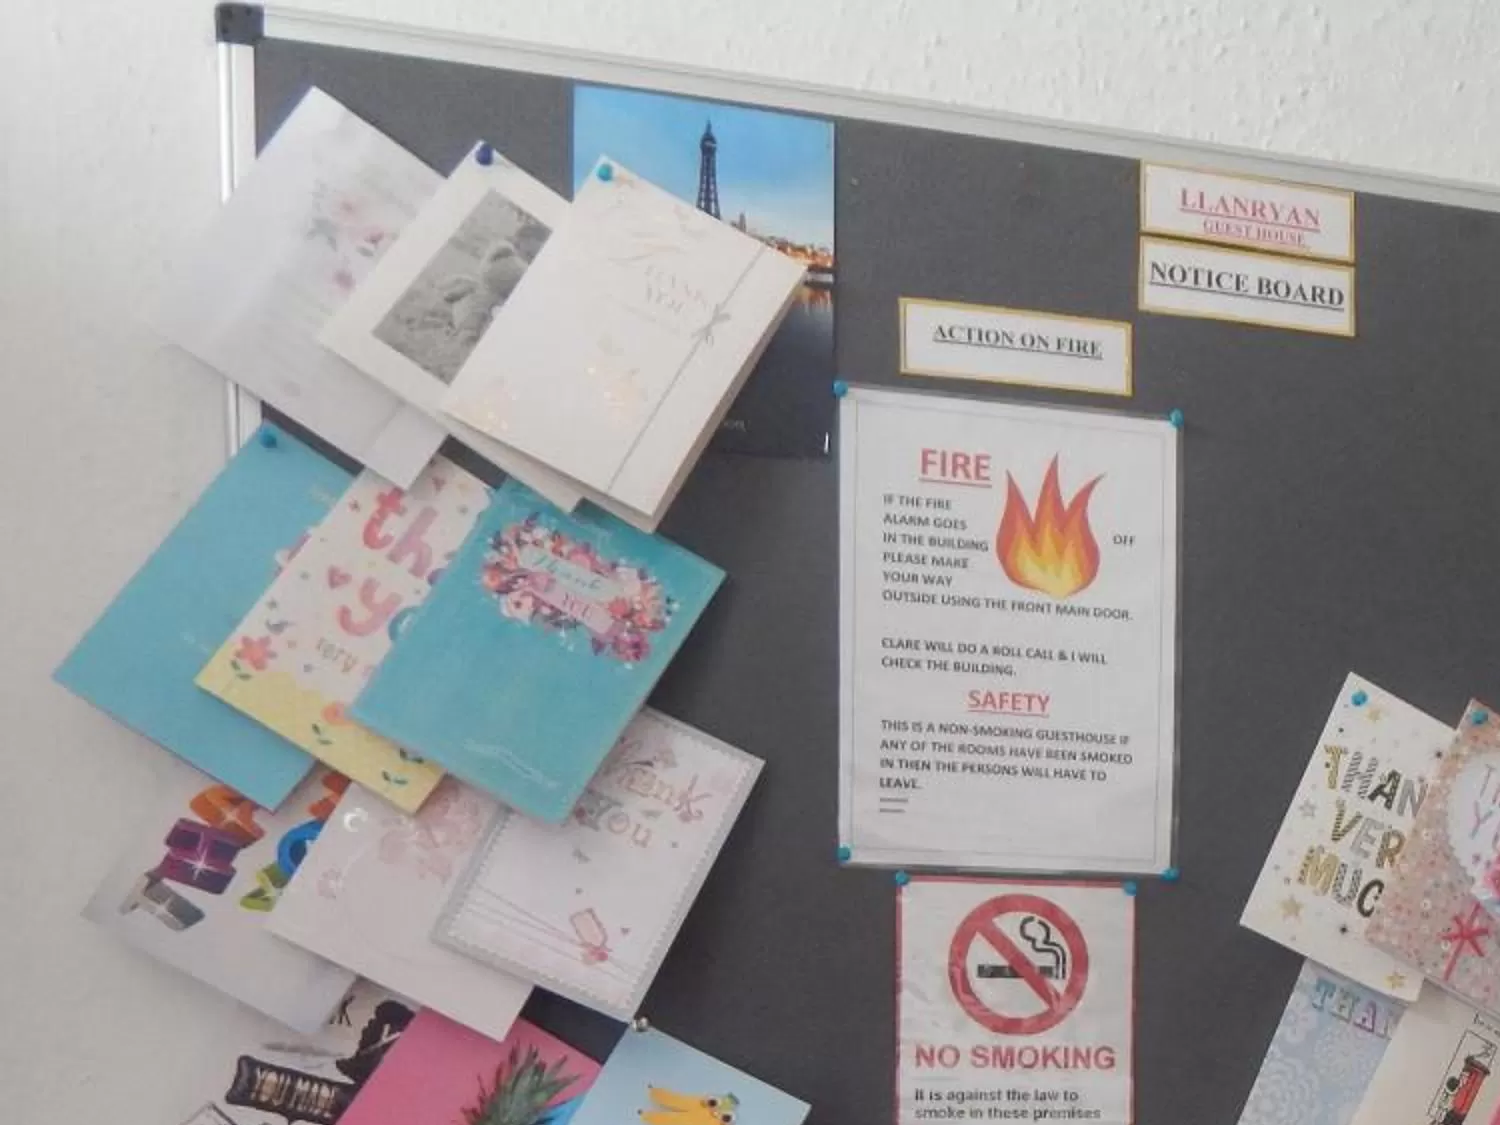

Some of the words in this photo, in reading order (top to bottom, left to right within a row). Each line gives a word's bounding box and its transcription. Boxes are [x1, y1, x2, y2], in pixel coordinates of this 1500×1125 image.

[1178, 187, 1321, 228] LLANRYAN
[1202, 218, 1251, 241] GUEST
[1255, 227, 1307, 249] HOUSE
[1150, 260, 1249, 293] NOTICE
[1256, 275, 1346, 307] BOARD
[932, 324, 1014, 348] ACTION
[1020, 333, 1049, 350] ON
[1056, 337, 1104, 358] FIRE
[921, 448, 992, 481] FIRE
[883, 494, 894, 504] IF
[899, 496, 922, 507] THE
[926, 498, 951, 509] FIRE
[883, 513, 929, 527] ALARM
[933, 518, 967, 530] GOES
[883, 532, 896, 543] IN
[901, 534, 924, 545] THE
[928, 536, 989, 552] BUILDING
[1113, 535, 1135, 545] OFF
[883, 552, 927, 565] PLEASE
[931, 557, 968, 568] MAKE
[883, 571, 919, 584] YOUR
[923, 575, 953, 586] WAY
[883, 590, 938, 604] OUTSIDE
[942, 594, 980, 608] USING
[985, 598, 1007, 610] THE
[1011, 599, 1052, 614] FRONT
[1056, 604, 1089, 617] MAIN
[882, 638, 921, 650] CLARE
[924, 641, 954, 653] WILL
[958, 643, 977, 655] DO
[980, 645, 989, 655] A
[993, 646, 1022, 658] ROLL
[1025, 648, 1053, 660] CALL
[1057, 650, 1068, 660] &
[1077, 651, 1107, 664] WILL
[882, 657, 922, 669] CHECK
[927, 660, 949, 672] THE
[968, 690, 1050, 712] SAFETY
[882, 720, 909, 732] THIS
[912, 722, 922, 732] IS
[926, 722, 935, 733] A
[939, 723, 1032, 739] NON-SMOKING
[1036, 730, 1116, 744] GUESTHOUSE
[1120, 735, 1129, 745] IF
[881, 739, 905, 750] ANY
[910, 740, 926, 751] OF
[931, 741, 953, 753] THE
[958, 743, 1005, 756] ROOMS
[1009, 746, 1040, 758] HAVE
[1045, 748, 1076, 761] BEEN
[1080, 752, 1133, 765] SMOKED
[881, 758, 894, 769] IN
[899, 759, 931, 771] THEN
[936, 761, 958, 773] THE
[962, 762, 1018, 776] PERSONS
[1021, 766, 1049, 779] WILL
[1054, 768, 1085, 781] HAVE
[1090, 771, 1107, 781] TO
[915, 1044, 960, 1067] NO
[971, 1046, 1116, 1070] SMOKING
[929, 1089, 942, 1101] is
[947, 1089, 1002, 1103] against
[1006, 1090, 1030, 1101] the
[1035, 1090, 1059, 1101] law
[1064, 1090, 1078, 1101] to
[915, 1106, 965, 1118] smoke
[970, 1107, 982, 1118] in
[988, 1107, 1028, 1119] these
[1034, 1107, 1101, 1121] premises
